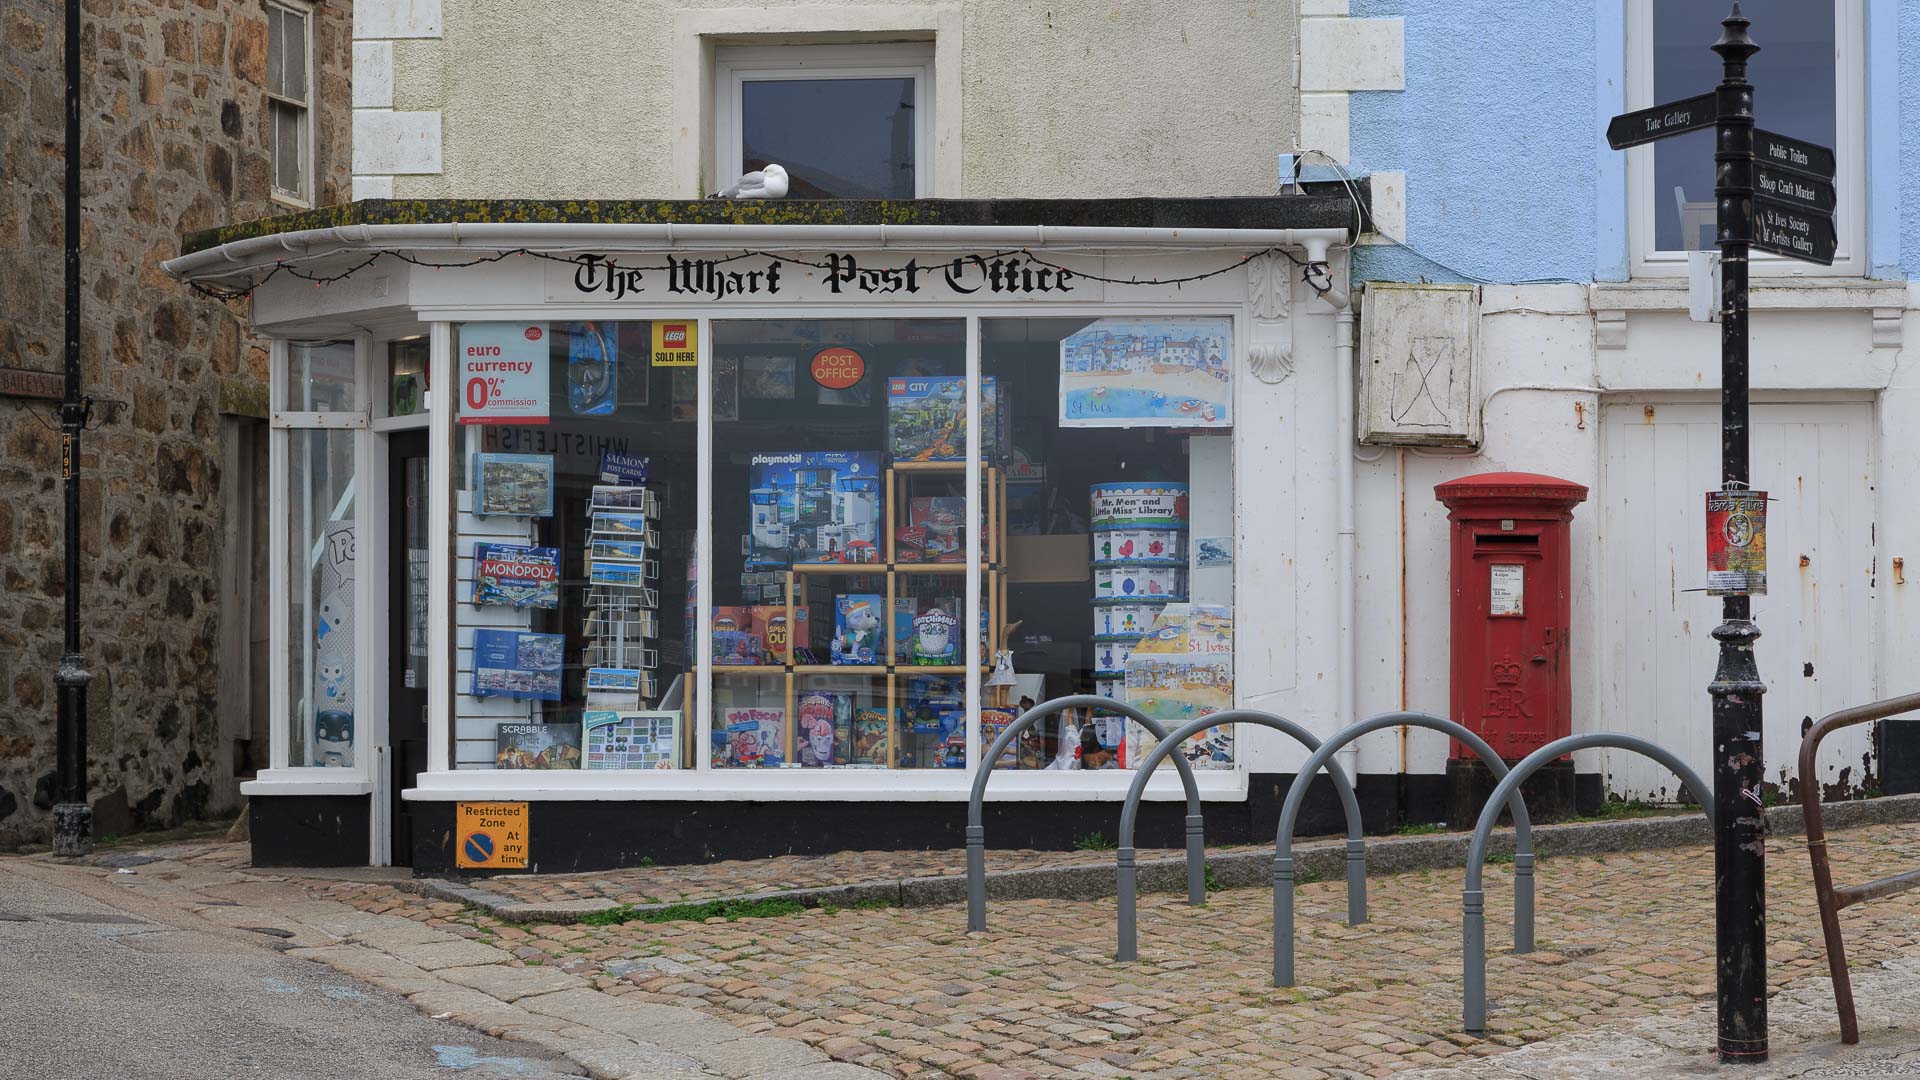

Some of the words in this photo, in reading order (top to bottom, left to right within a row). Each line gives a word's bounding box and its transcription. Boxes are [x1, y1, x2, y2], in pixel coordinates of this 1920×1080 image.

[1646, 117, 1662, 131] Tate
[1665, 110, 1692, 128] Gallery
[1769, 143, 1787, 160] Public
[1790, 148, 1808, 165] Toilets
[1759, 174, 1776, 193] Sloop
[1778, 180, 1794, 196] Craft
[1796, 183, 1815, 201] Market
[1767, 210, 1774, 223] St
[1775, 213, 1787, 228] Ives
[1789, 216, 1810, 233] Society
[1772, 231, 1791, 248] Artists
[1792, 235, 1814, 255] Gallery
[575, 253, 645, 300] The
[667, 253, 782, 301] Wharf
[822, 253, 921, 294] Post
[945, 254, 1075, 294] Office
[664, 331, 686, 341] LEGO
[467, 345, 501, 356] euro
[655, 352, 675, 362] SOLD
[676, 351, 695, 362] HERE
[821, 355, 855, 366] POST
[467, 361, 533, 374] currency
[815, 367, 859, 379] OFFICE
[909, 382, 929, 391] CITY
[488, 398, 537, 406] commission
[606, 454, 645, 469] SALMON
[752, 453, 802, 466] playmobil
[607, 464, 622, 472] POST
[622, 468, 642, 477] CARDS
[1102, 498, 1114, 507] Mr.
[1142, 497, 1161, 505] and
[1095, 507, 1111, 516] Little
[1113, 507, 1133, 515] Miss
[1139, 506, 1173, 516] Library
[484, 563, 554, 579] MONOPOLY
[913, 612, 957, 627] HATCHIMALS
[769, 625, 787, 633] SPEA
[768, 633, 787, 644] OU
[1188, 640, 1202, 652] St
[1205, 640, 1230, 652] Ives
[502, 725, 548, 735] SCRABBLE
[466, 807, 520, 816] Restricted
[480, 819, 506, 827] Zone
[507, 832, 520, 840] At
[504, 844, 522, 853] any
[501, 855, 525, 863] time
